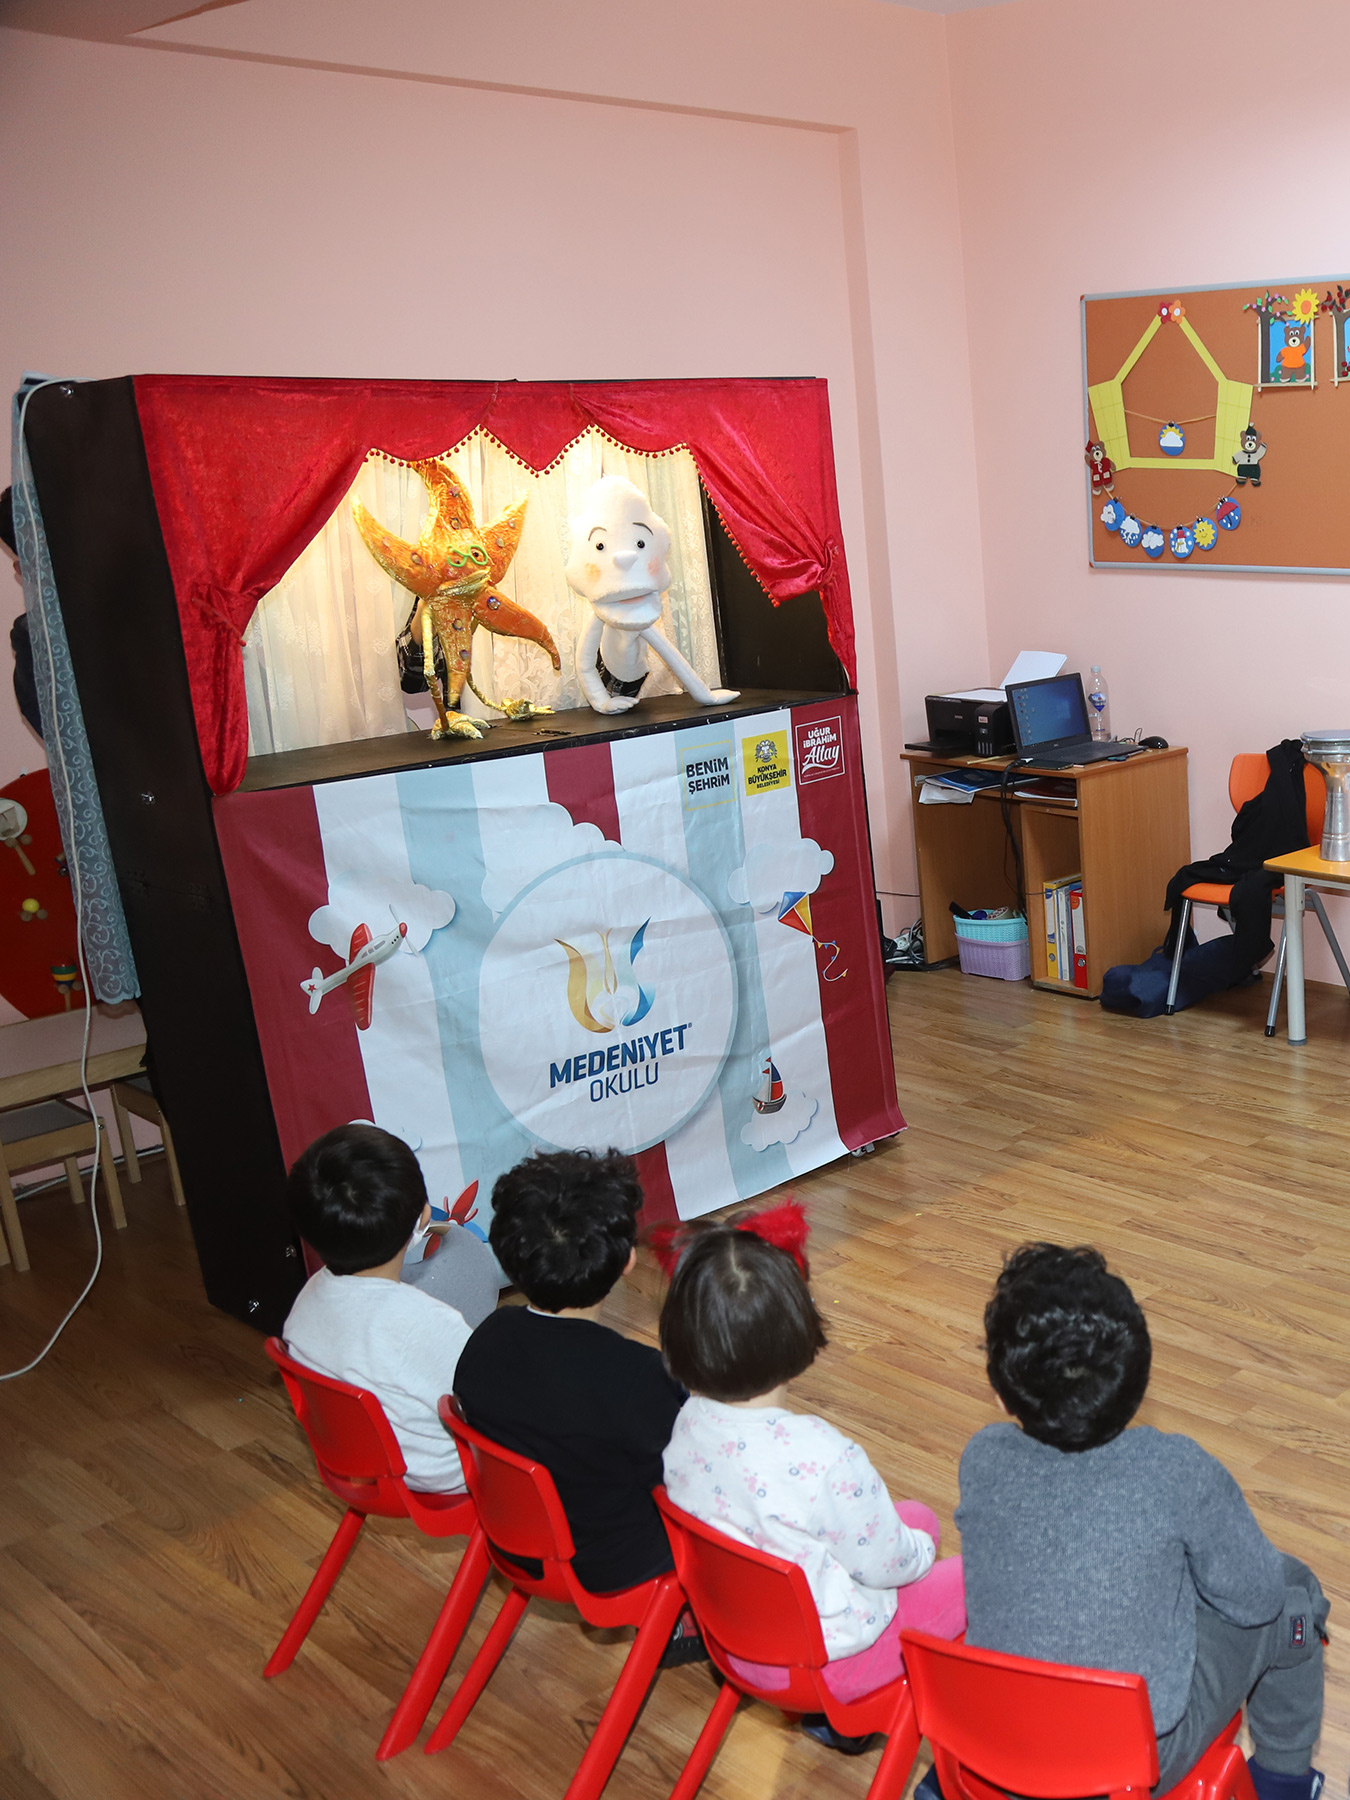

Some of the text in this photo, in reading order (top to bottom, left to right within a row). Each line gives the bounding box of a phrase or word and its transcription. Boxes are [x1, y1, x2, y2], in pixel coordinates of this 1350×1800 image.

[807, 726, 831, 739] UĞUR
[757, 763, 777, 773] KONYA
[801, 745, 840, 773] Altay
[590, 1062, 659, 1103] OKULU
